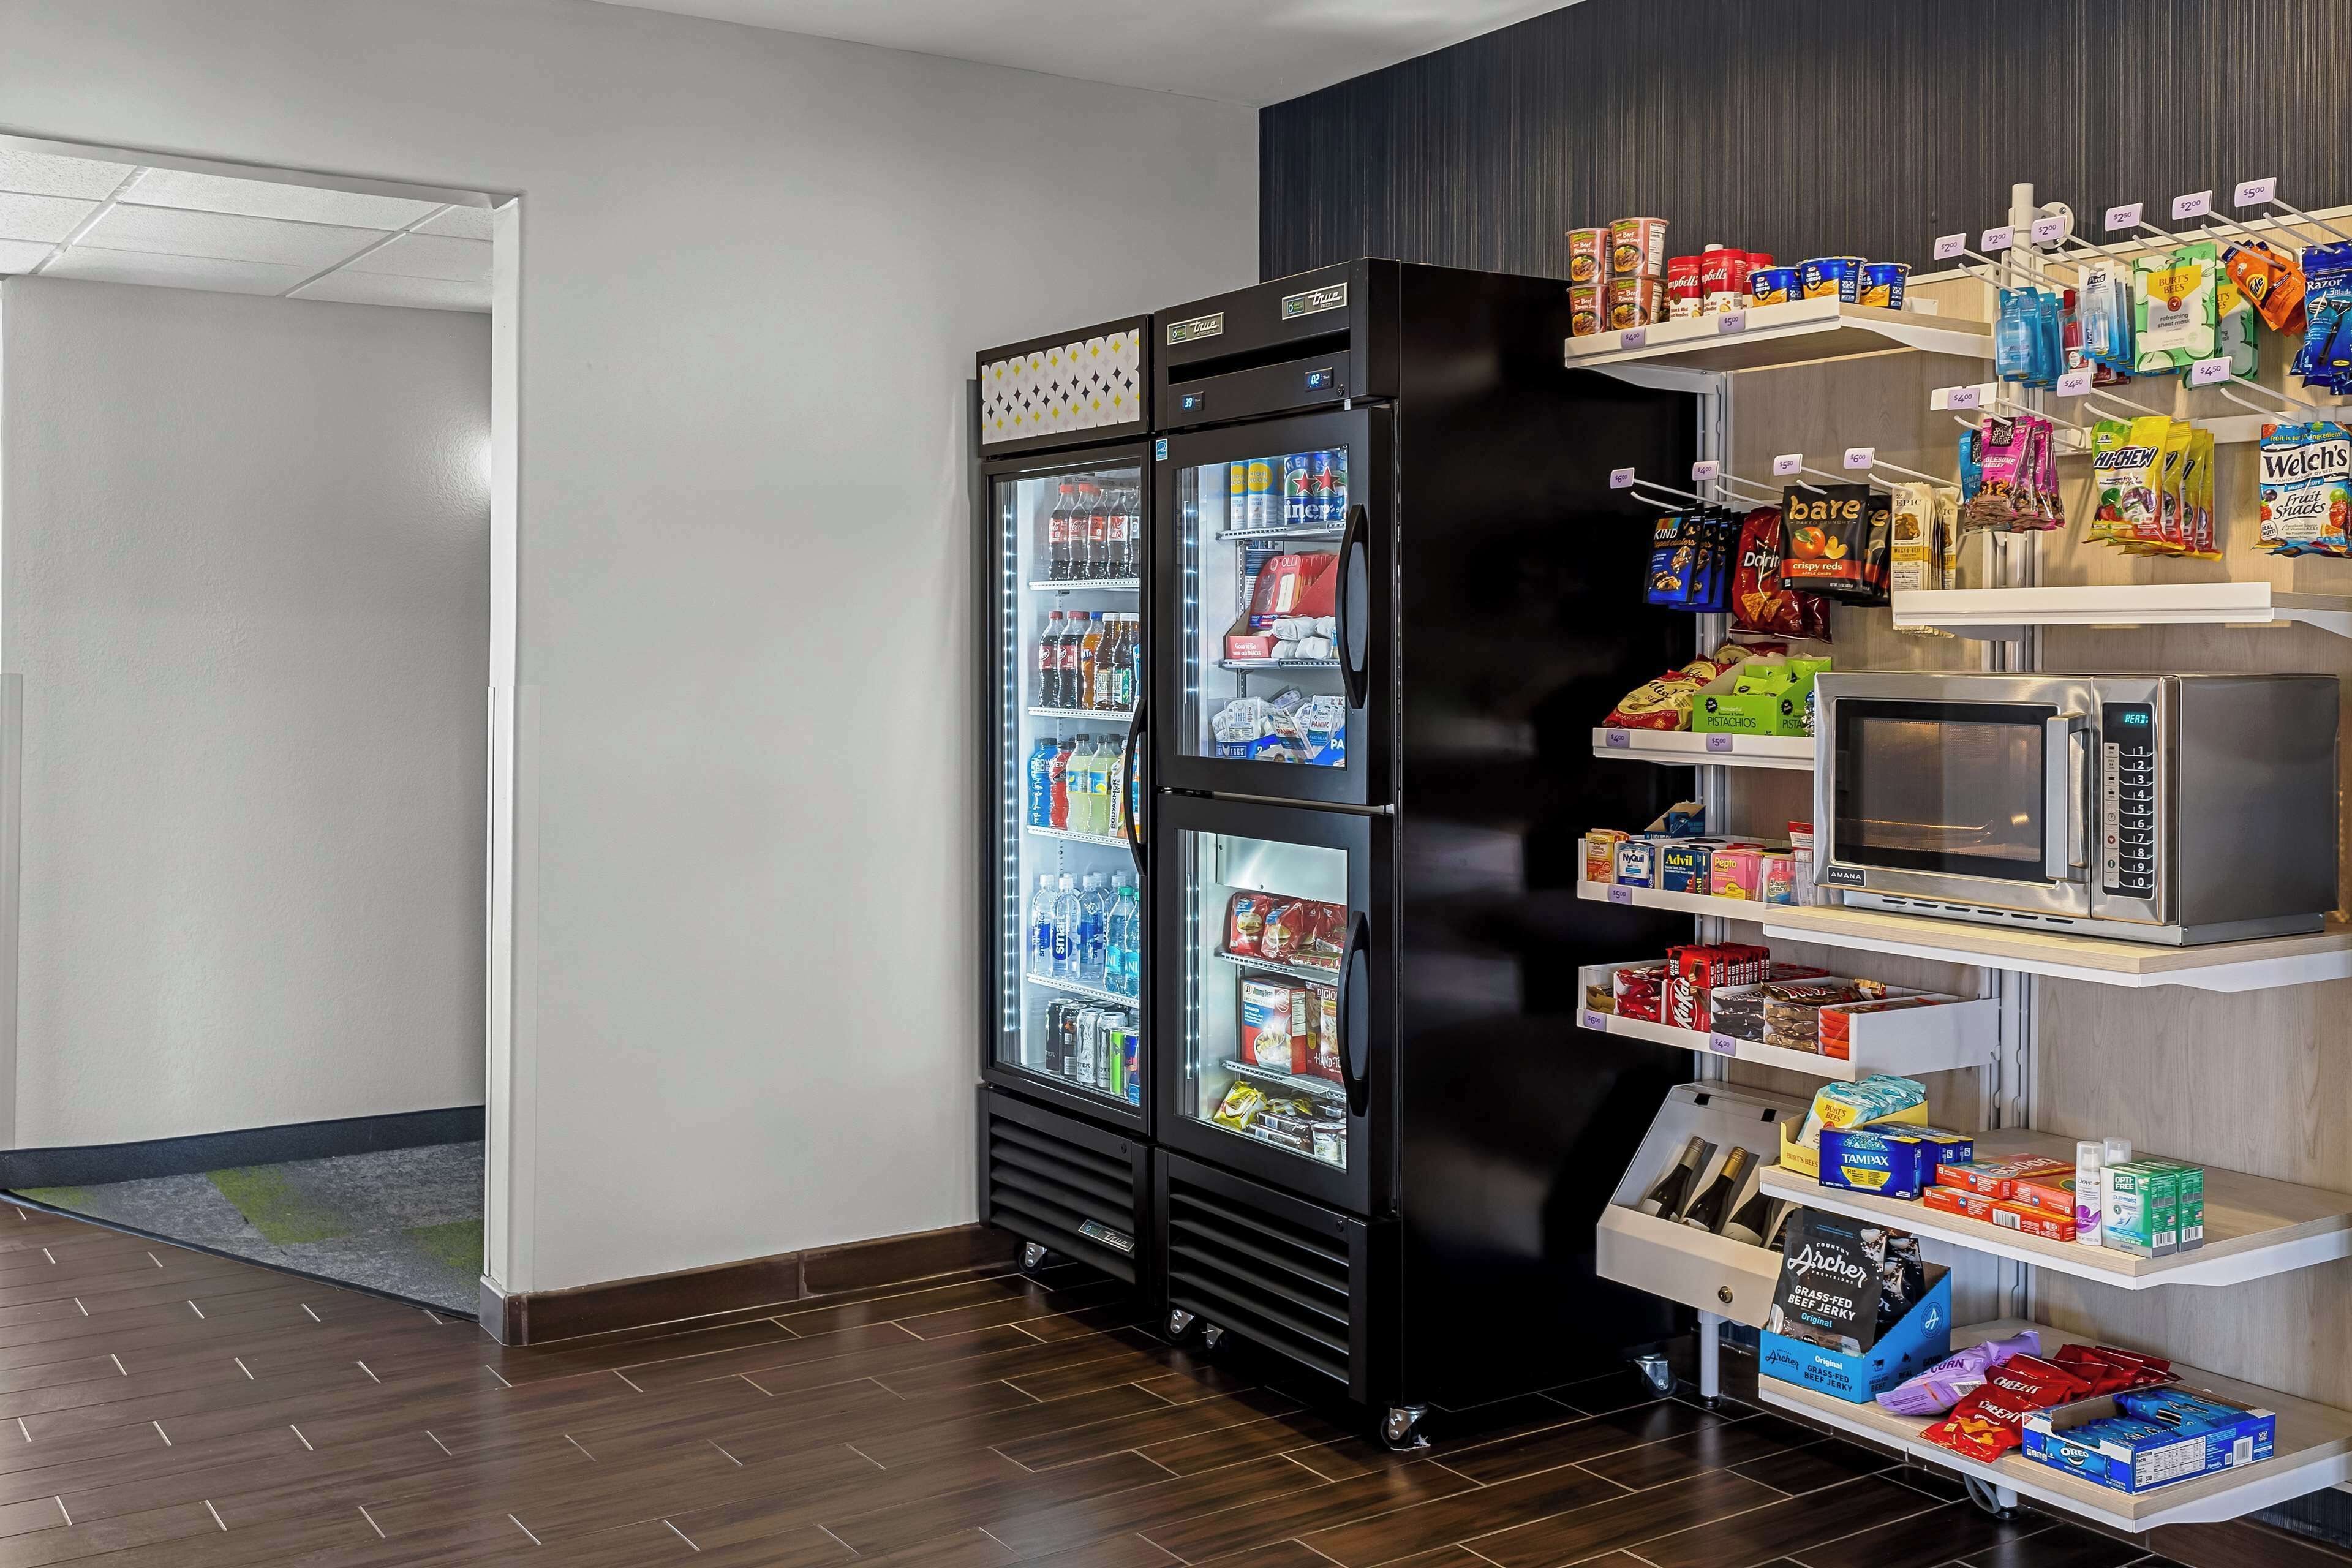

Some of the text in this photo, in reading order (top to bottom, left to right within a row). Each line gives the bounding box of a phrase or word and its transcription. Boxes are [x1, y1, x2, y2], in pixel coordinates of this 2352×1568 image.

[2159, 274, 2189, 287] BURT'S
[2250, 277, 2264, 295] Tide
[2307, 279, 2342, 292] Razor
[2164, 284, 2185, 294] BEES
[2160, 313, 2189, 322] refreshing
[1185, 398, 1193, 407] 39
[1985, 456, 2015, 465] OLESOME
[2095, 447, 2157, 468] HI-CHEW
[2263, 445, 2347, 478] Welch's
[2285, 491, 2322, 507] Fruit
[1789, 495, 1861, 520] bare
[2274, 502, 2326, 520] Snacks
[1654, 528, 1677, 540] KIND
[1282, 557, 1297, 567] OLLI
[1793, 562, 1820, 571] crispy
[1708, 717, 1756, 728] PISTACHIOS
[1783, 719, 1802, 729] PISTA
[2138, 746, 2143, 755] 1
[2138, 761, 2144, 769] 2
[2138, 775, 2144, 784] 3
[2138, 790, 2144, 799] 4
[2138, 804, 2144, 813] 5
[2138, 819, 2144, 827] 6
[2138, 834, 2144, 842] 7
[1623, 853, 1645, 863] NyQuil
[2138, 848, 2144, 857] 8
[1665, 854, 1692, 866] Advil
[1715, 858, 1737, 869] Pepto
[2138, 862, 2144, 872] 9
[2138, 877, 2144, 886] 0
[1055, 916, 1065, 954] smart
[1317, 989, 1336, 1000] DIGIO
[1825, 1104, 1846, 1117] BURT'S
[1826, 1112, 1842, 1122] BEES
[1787, 1153, 1818, 1167] BURT'S BEES
[1842, 1153, 1889, 1166] TAMPAX
[1816, 1242, 1850, 1256] COUNTRY
[1787, 1244, 1868, 1288] Archer
[1812, 1270, 1853, 1284] PROVISIONS
[1795, 1285, 1852, 1309] GRASS-FED
[1788, 1294, 1856, 1321] BEEF JERKY
[1801, 1312, 1833, 1328] Original
[1765, 1349, 1800, 1370] Archer
[1815, 1355, 1843, 1370] Original
[1807, 1365, 1849, 1383] GRASS-FED
[1804, 1371, 1853, 1392] BEEF JERKY
[1871, 1382, 1886, 1392] BEEF
[2060, 1447, 2089, 1458] OREO
